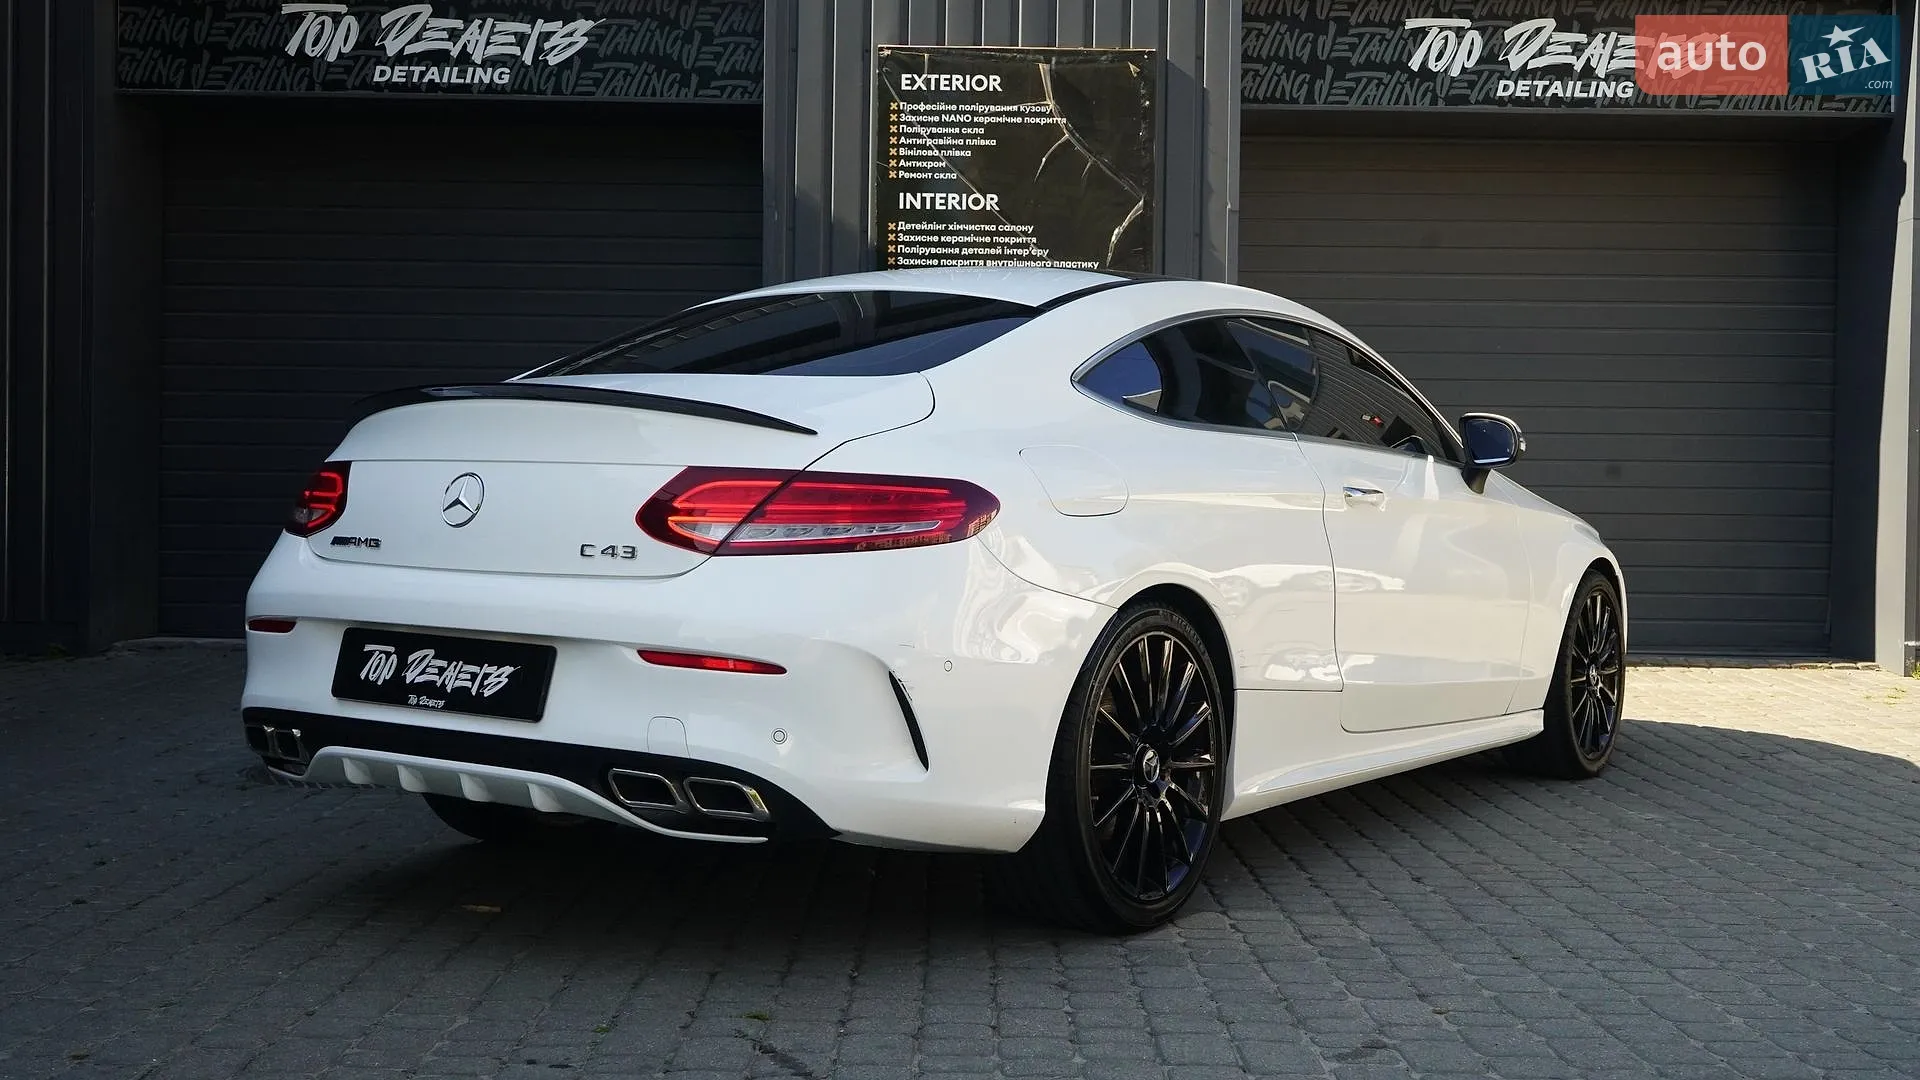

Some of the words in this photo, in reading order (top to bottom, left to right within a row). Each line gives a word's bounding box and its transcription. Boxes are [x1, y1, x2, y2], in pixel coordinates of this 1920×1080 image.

[373, 65, 511, 84] DETAILING
[900, 73, 1003, 92] EXTERIOR
[1496, 80, 1635, 99] DETAILING
[900, 101, 957, 112] Професійне
[958, 102, 1018, 114] полірування
[1019, 104, 1051, 115] кузову
[899, 114, 940, 123] Захисне
[942, 114, 972, 123] NANO
[973, 115, 1023, 125] керамічне
[1024, 116, 1067, 125] покриття
[899, 125, 960, 136] Полірування
[962, 127, 985, 135] скла
[899, 136, 964, 147] Антигравійна
[965, 138, 997, 147] плівка
[899, 147, 939, 157] Вінілова
[940, 149, 972, 157] плівка
[898, 159, 946, 168] Антихром
[898, 170, 933, 180] Ремонт
[934, 172, 957, 180] скла
[898, 191, 1001, 211] INTERIOR
[897, 222, 947, 232] Детейлінг
[948, 223, 996, 232] хімчистка
[997, 224, 1034, 234] салону
[897, 233, 939, 242] Захисне
[940, 234, 991, 244] керамічне
[992, 236, 1037, 245] покриття
[897, 244, 960, 256] Полірування
[961, 246, 1002, 256] деталей
[897, 257, 939, 266] Захисне
[940, 258, 985, 268] покриття
[1053, 260, 1100, 270] пластику
[579, 543, 596, 558] C
[600, 544, 638, 560] 43
